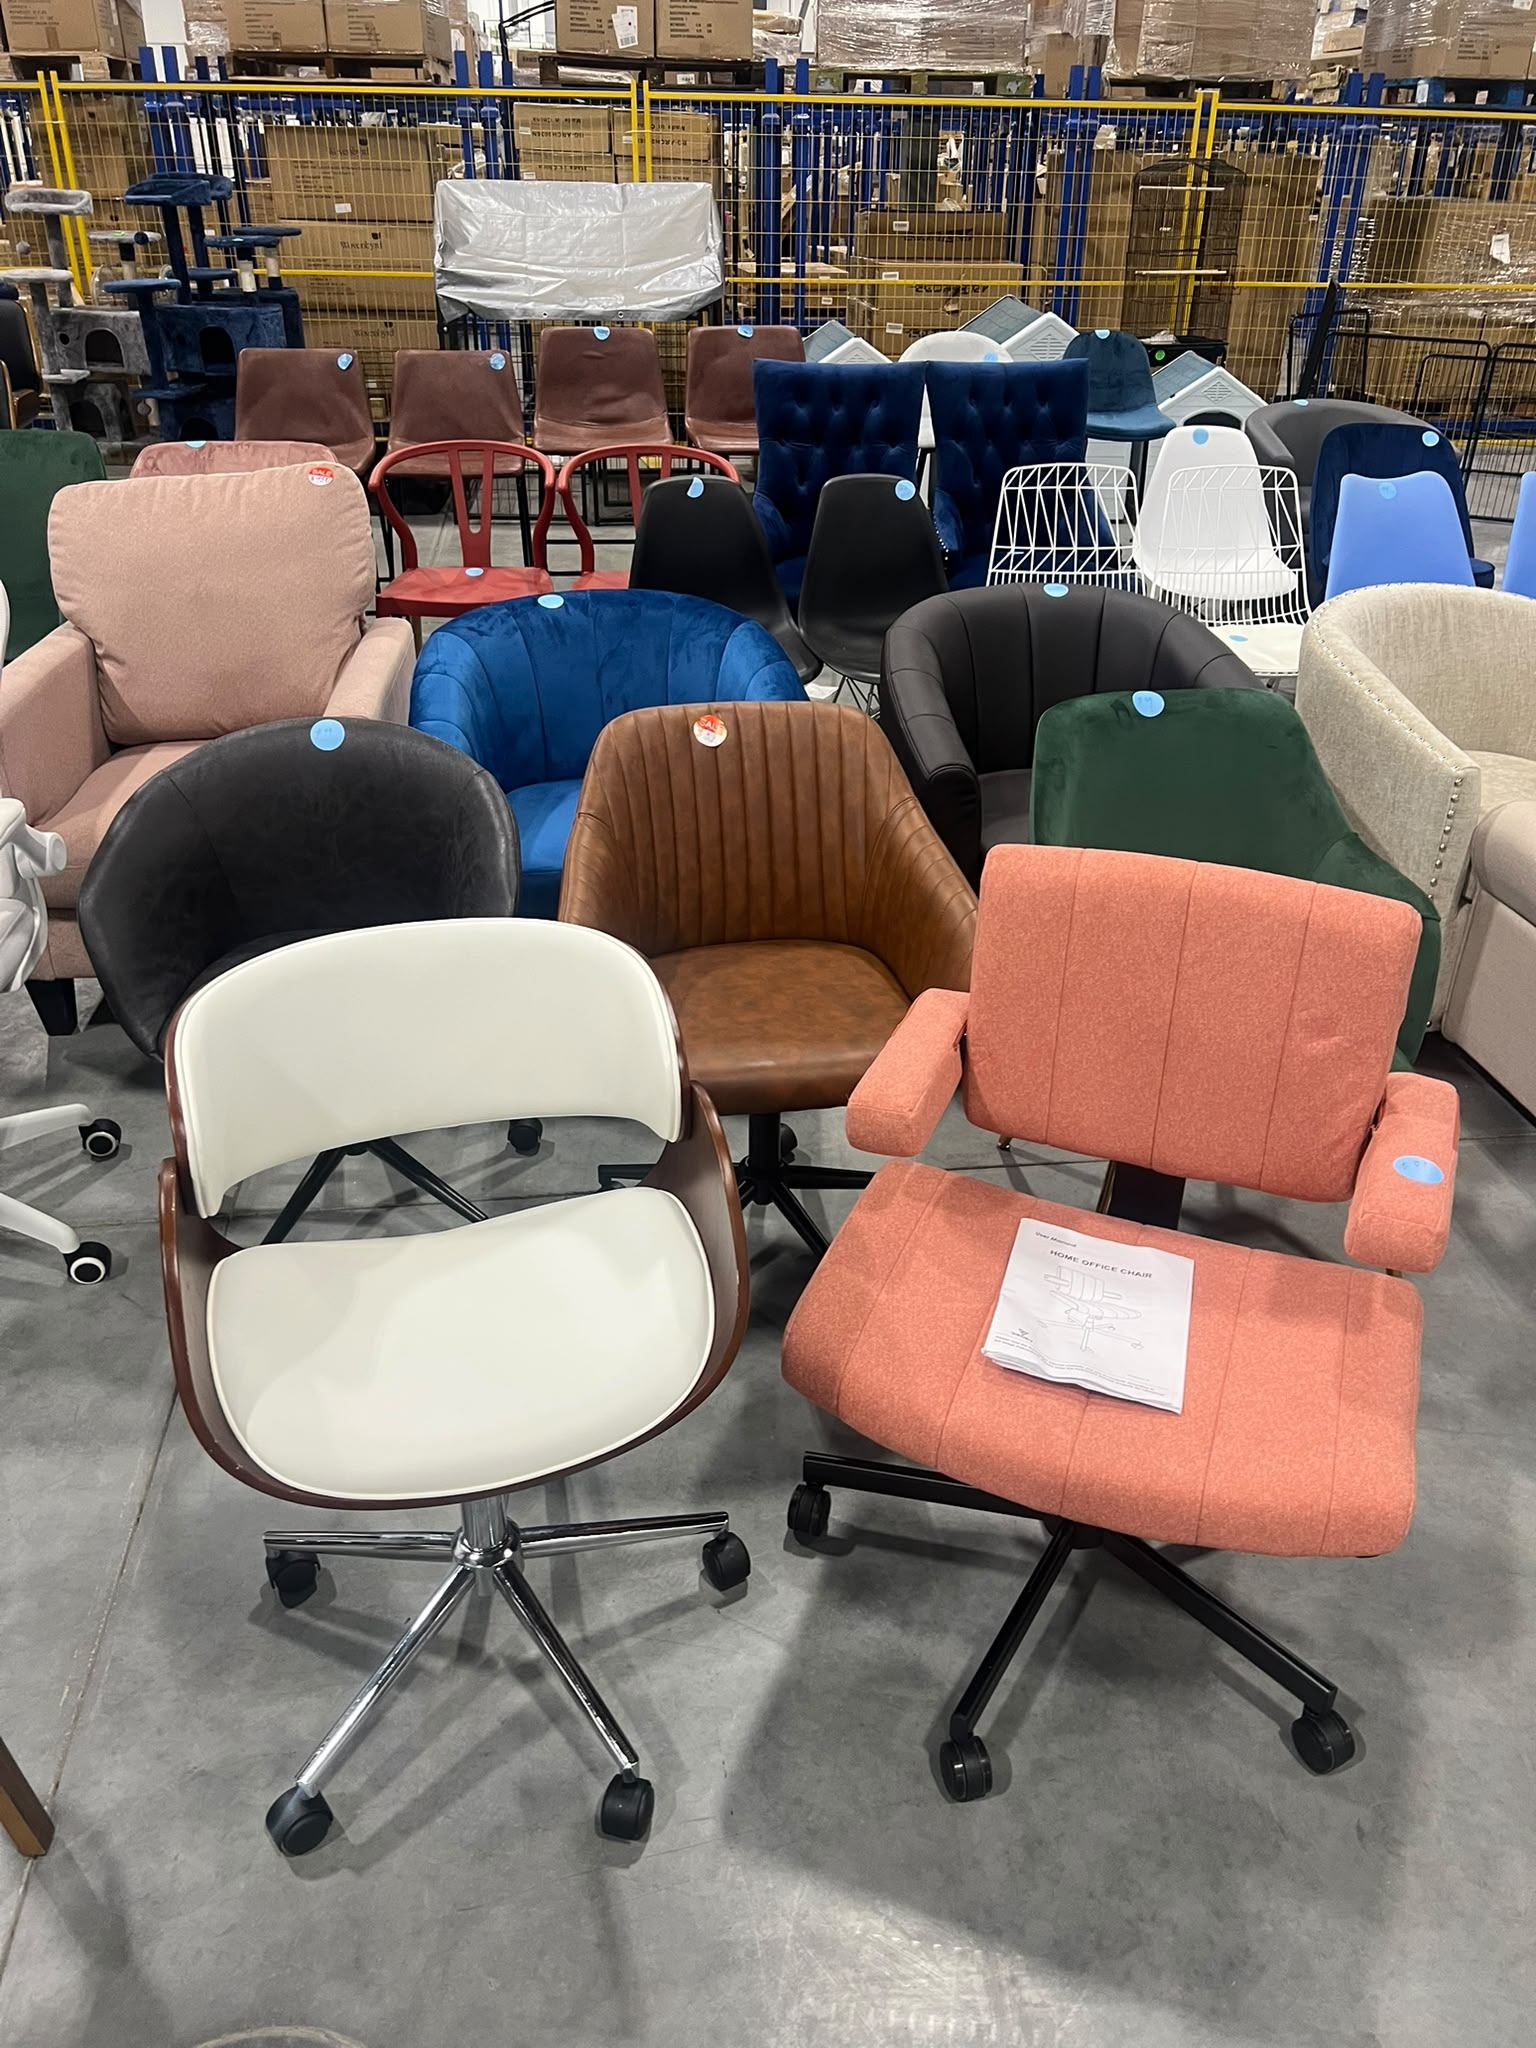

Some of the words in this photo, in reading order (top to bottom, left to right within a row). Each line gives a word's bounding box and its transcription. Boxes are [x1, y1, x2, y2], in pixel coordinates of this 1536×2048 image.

[699, 718, 725, 731] SALE
[1034, 1231, 1050, 1240] User
[1049, 1249, 1080, 1263] HOME
[1081, 1259, 1118, 1273] OFFICE
[1119, 1268, 1153, 1279] CHAIR
